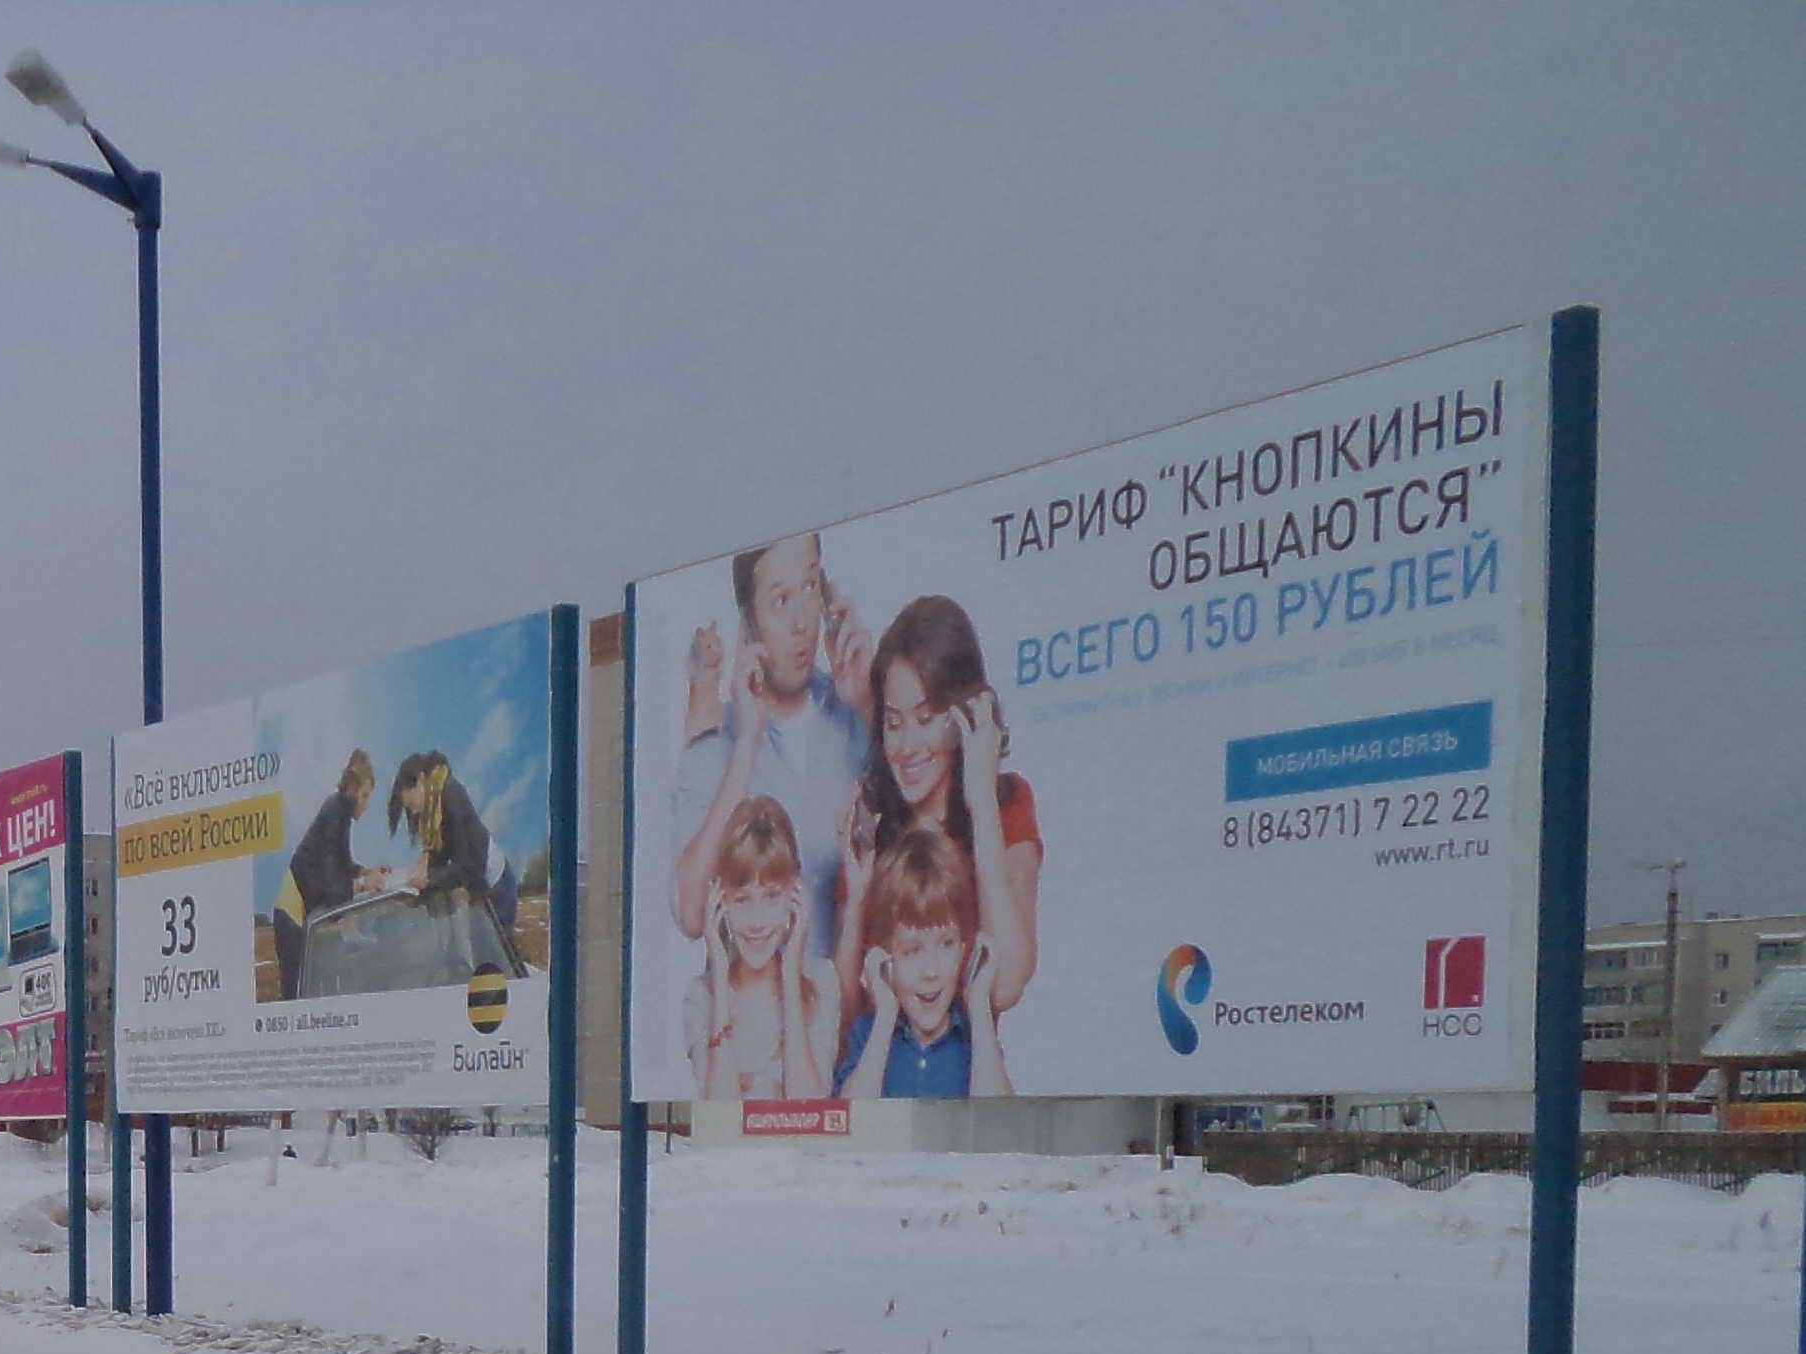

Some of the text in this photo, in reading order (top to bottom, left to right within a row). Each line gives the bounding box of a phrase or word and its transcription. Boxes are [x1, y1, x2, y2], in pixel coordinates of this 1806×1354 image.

[992, 479, 1148, 561] ТАРИФ
[1016, 528, 1498, 687] ВСЕГО 150 РУБЛЕЙ
[169, 752, 281, 800] включено»
[1257, 730, 1458, 776] МОБИЛЬНАЯ СВЯЗЬ
[6, 799, 56, 857] ЦЕН!
[124, 807, 269, 865] по всей России
[1223, 785, 1490, 849] 8 (84371) 7 22 22
[1375, 837, 1490, 867] www.rt.ru
[161, 895, 196, 957] 33
[144, 967, 220, 1003] руб/сутки
[1215, 1000, 1365, 1026] Ростелеком
[1422, 1014, 1484, 1037] НСС
